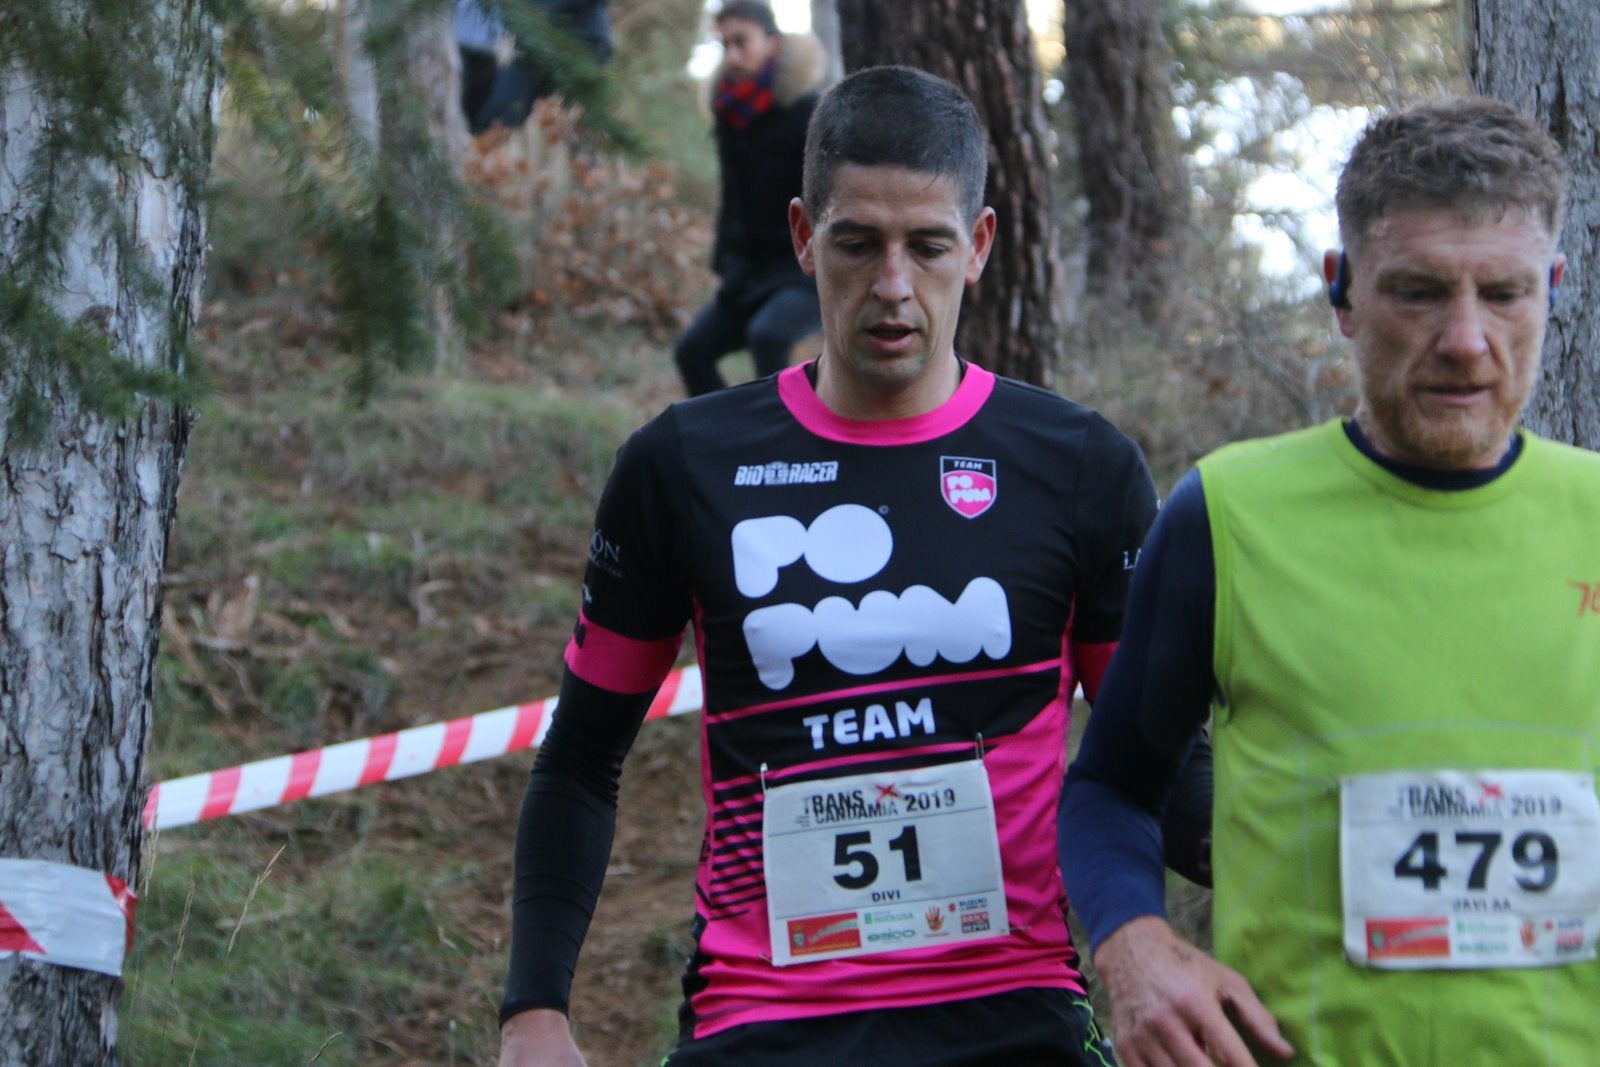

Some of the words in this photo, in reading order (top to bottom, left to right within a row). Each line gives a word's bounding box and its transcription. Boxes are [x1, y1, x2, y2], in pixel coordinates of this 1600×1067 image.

[953, 460, 983, 470] TEAM
[802, 697, 936, 750] TEAM
[904, 788, 957, 812] 2019
[1511, 793, 1562, 817] 2019
[833, 825, 922, 890] 51
[1394, 830, 1559, 893] 479
[871, 890, 901, 902] DIVI
